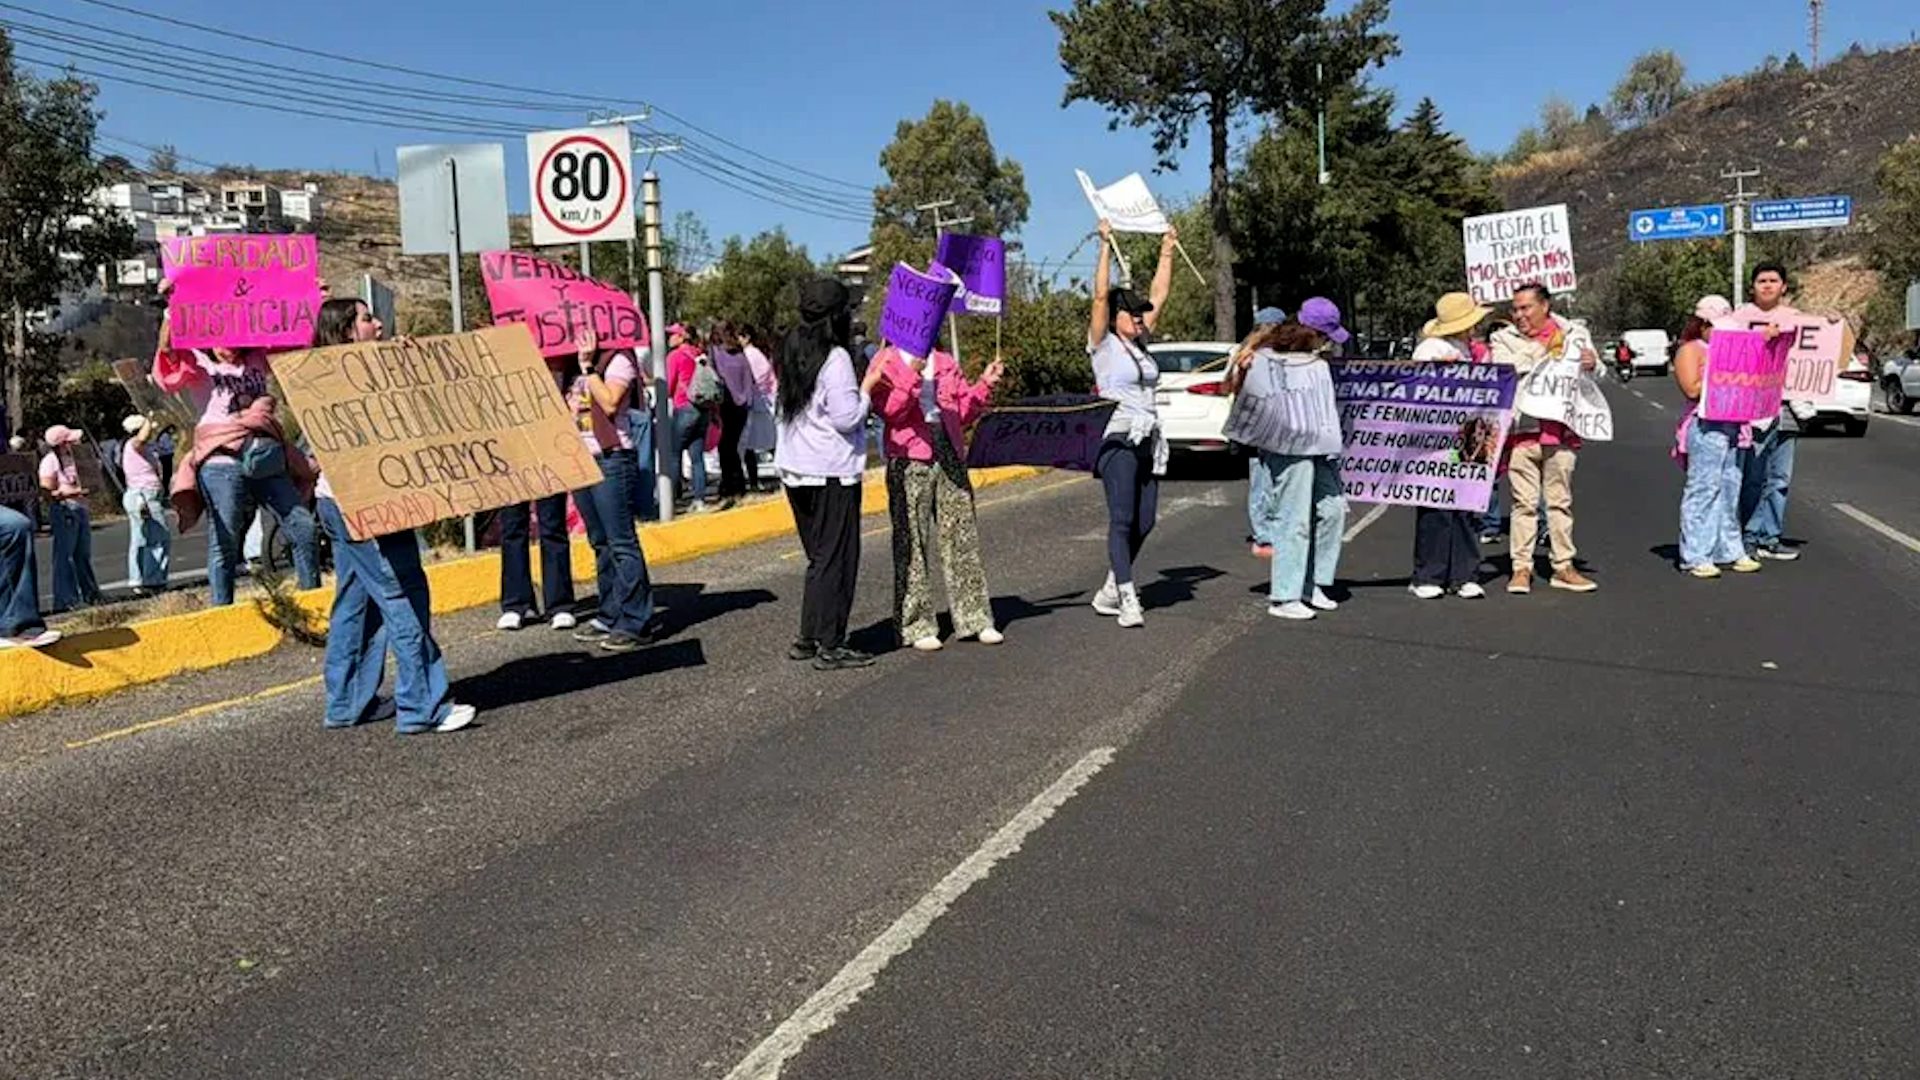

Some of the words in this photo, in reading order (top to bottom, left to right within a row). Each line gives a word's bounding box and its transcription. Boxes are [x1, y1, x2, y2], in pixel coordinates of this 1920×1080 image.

[552, 152, 609, 201] 80
[1466, 216, 1534, 243] MOLESTA
[1541, 212, 1559, 235] EL
[161, 238, 309, 271] VERDAD
[1470, 254, 1540, 282] MOLESTA
[234, 278, 254, 297] &
[174, 300, 314, 338] JUSTICIA
[342, 337, 468, 393] QUEREMOS
[458, 334, 502, 378] LA
[1340, 361, 1437, 377] JUSTICIA
[1441, 363, 1499, 382] PARA
[444, 367, 562, 432] CORRECTA
[1335, 381, 1407, 400] ENATA
[1414, 385, 1501, 404] PALMER
[1342, 404, 1371, 420] FUE
[1374, 405, 1467, 424] FEMINICIDIO
[1352, 430, 1383, 447] FUE
[1384, 432, 1464, 450] HOMICIDIO
[378, 439, 508, 489] QUEREMOS
[1404, 459, 1487, 481] CORRECTA
[1371, 482, 1380, 497] Y
[1383, 483, 1456, 504] JUSTICIA
[344, 492, 437, 539] VERDAD
[433, 484, 455, 515] Y
